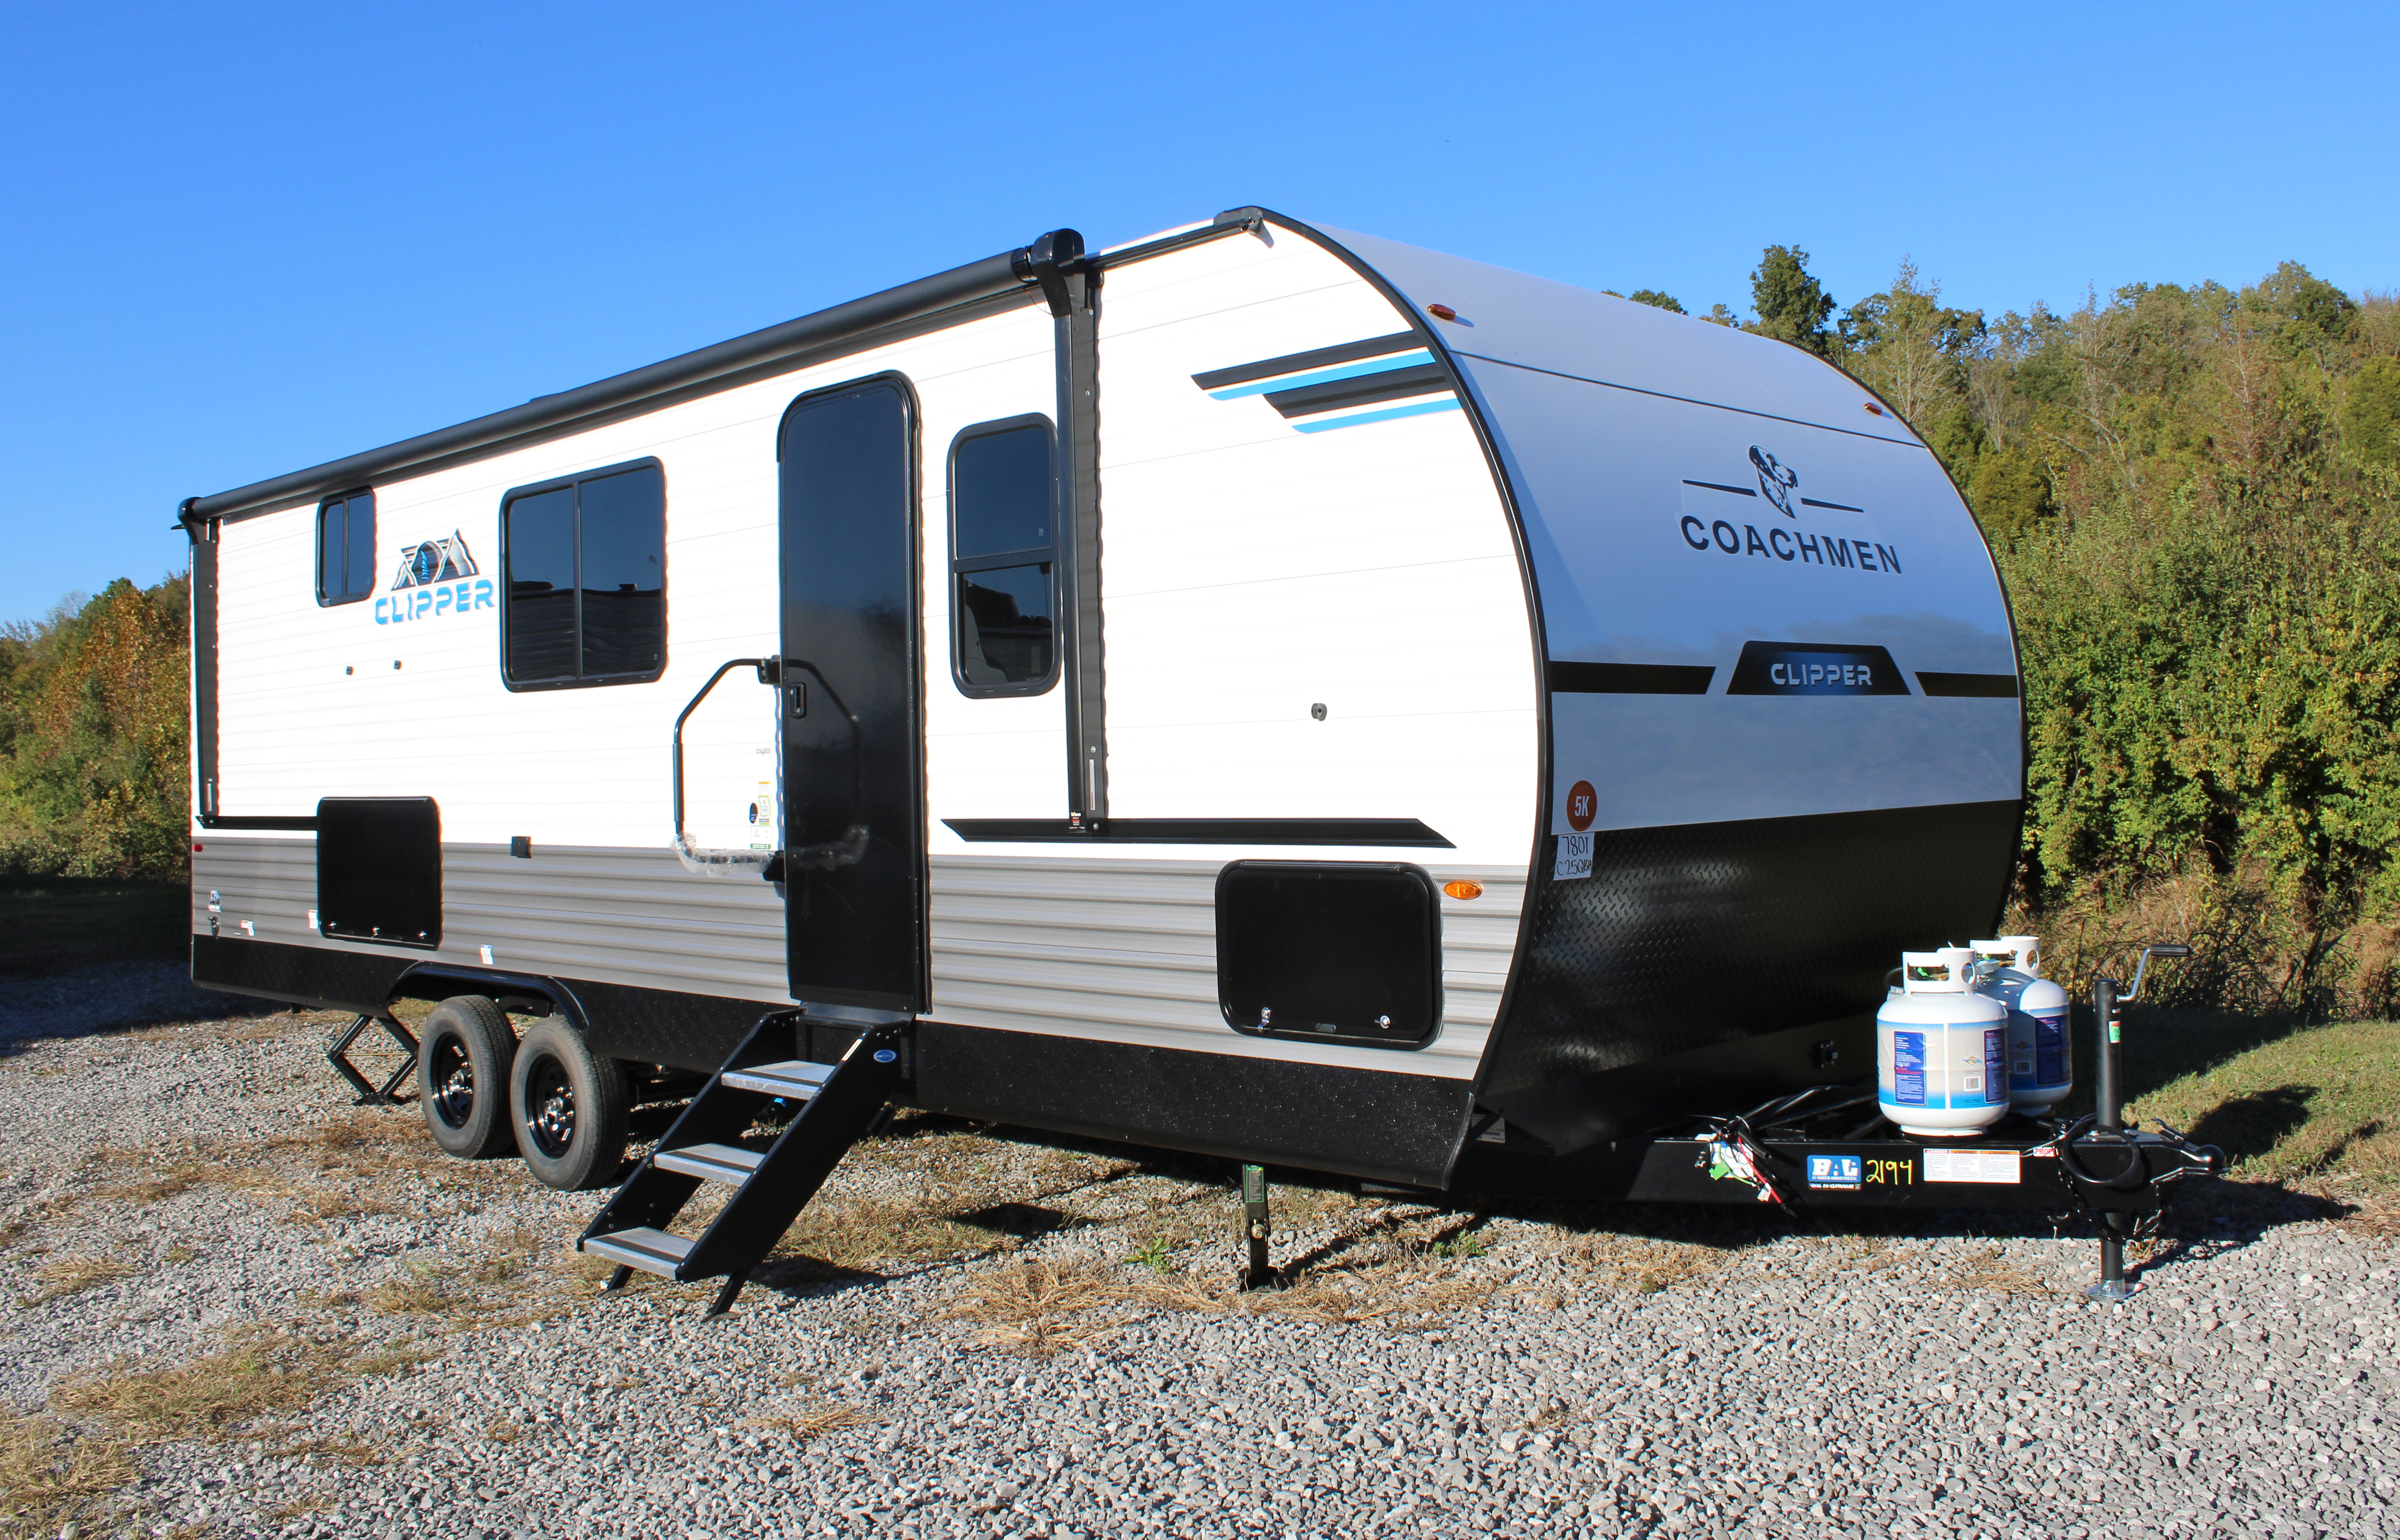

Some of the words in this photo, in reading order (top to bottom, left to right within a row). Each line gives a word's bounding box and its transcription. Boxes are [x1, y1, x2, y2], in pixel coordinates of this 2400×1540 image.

[1681, 515, 1902, 574] COACHMEN
[375, 579, 495, 625] CLIPPER
[1771, 663, 1873, 687] CLIPPER
[1575, 796, 1590, 817] 5K
[1561, 836, 1588, 856] 7801
[1812, 1158, 1859, 1176] BAL
[1866, 1159, 1913, 1185] 2194
